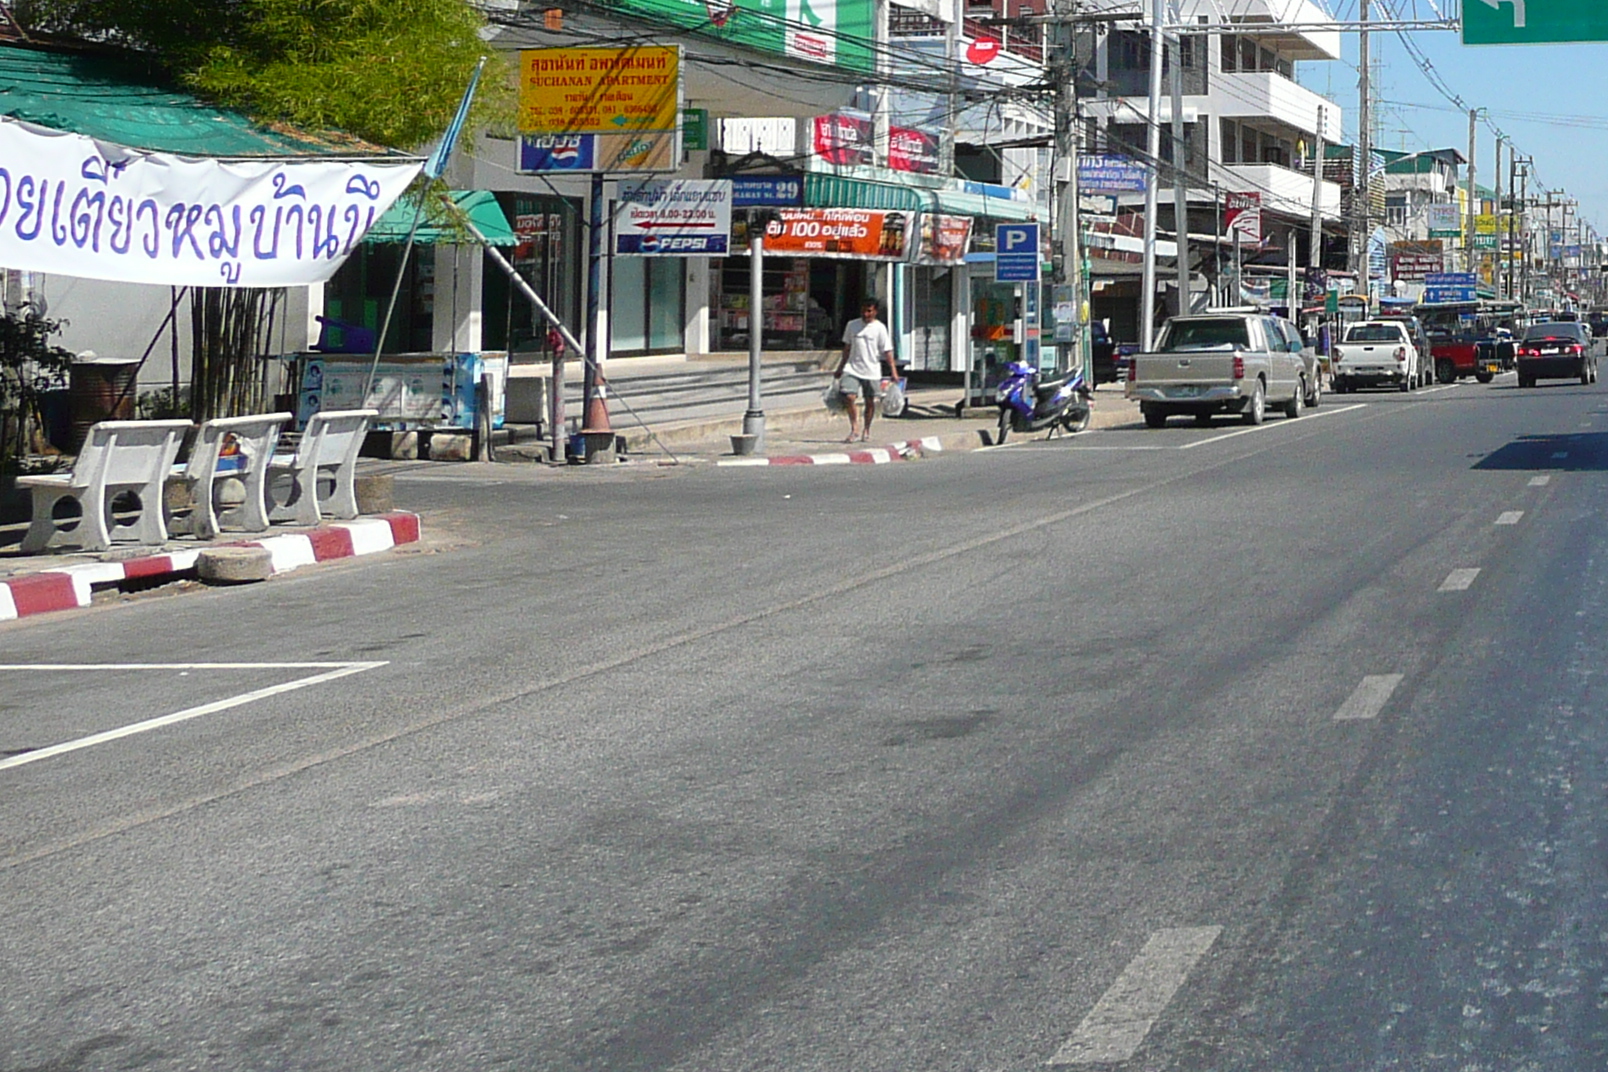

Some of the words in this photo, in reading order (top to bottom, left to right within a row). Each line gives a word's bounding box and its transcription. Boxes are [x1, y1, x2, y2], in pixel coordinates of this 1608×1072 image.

[530, 76, 592, 87] SUCHANAN
[599, 75, 669, 86] APARTMENT
[776, 180, 799, 200] 29
[791, 221, 819, 237] 100
[661, 238, 708, 249] PEPSI
[1006, 230, 1027, 250] P
